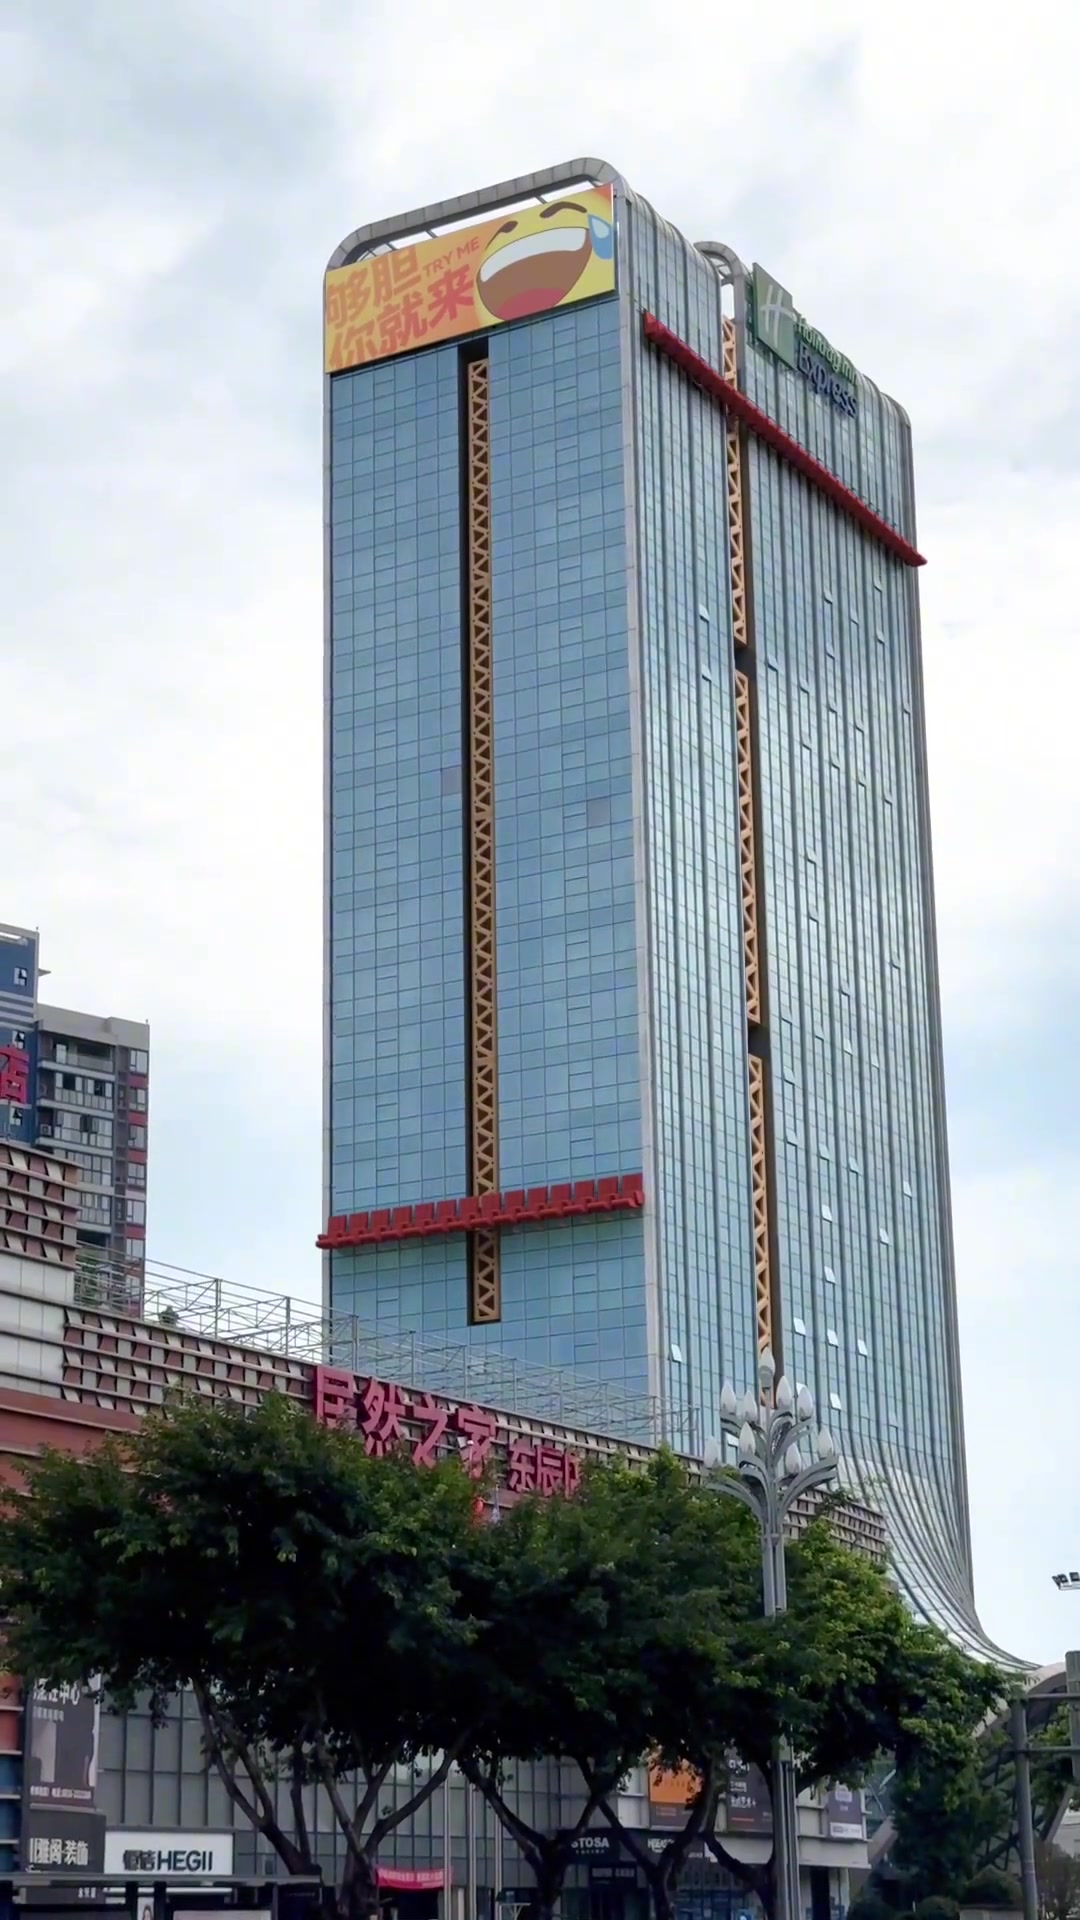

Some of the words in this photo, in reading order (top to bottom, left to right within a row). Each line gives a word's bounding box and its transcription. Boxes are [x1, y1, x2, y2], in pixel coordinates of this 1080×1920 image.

[423, 253, 454, 277] TRY
[456, 237, 479, 258] ME
[327, 248, 422, 328] 够胆
[328, 264, 474, 369] 你就来
[157, 1850, 213, 1871] HEGII
